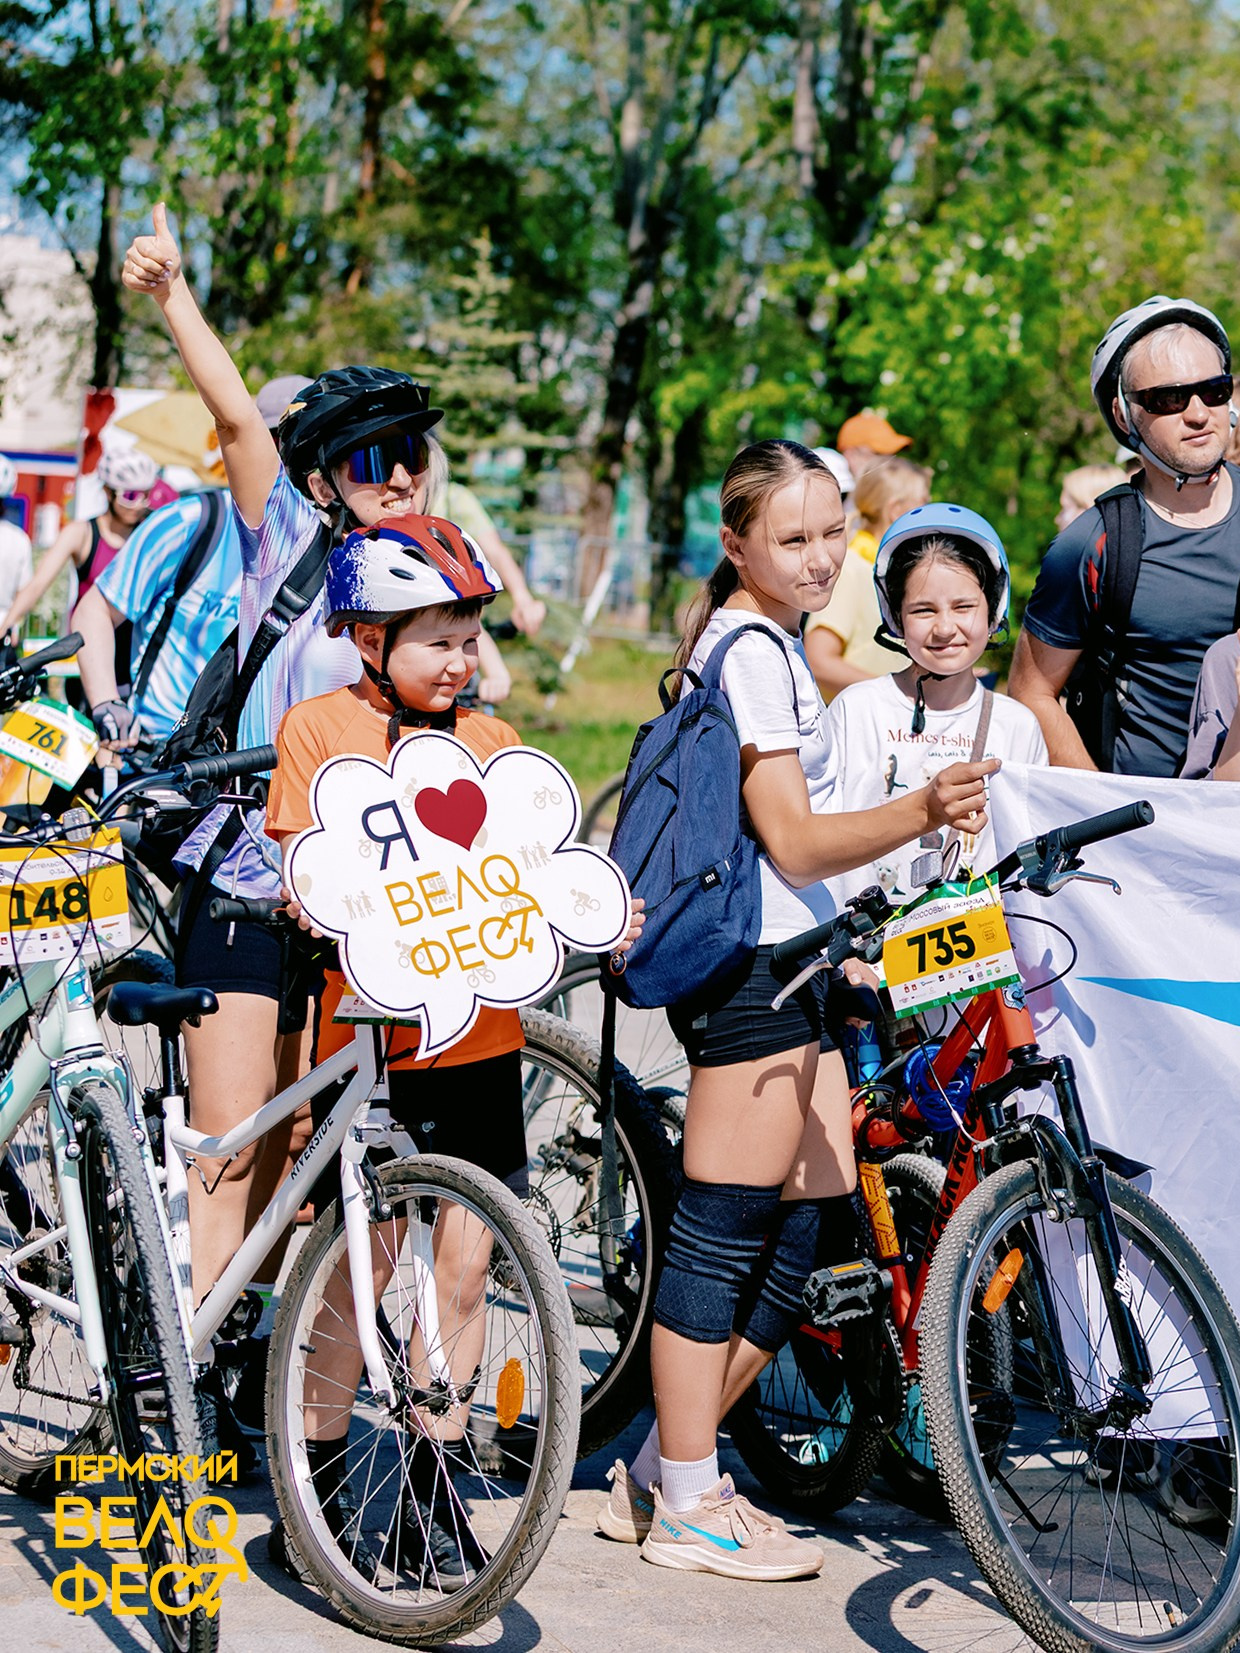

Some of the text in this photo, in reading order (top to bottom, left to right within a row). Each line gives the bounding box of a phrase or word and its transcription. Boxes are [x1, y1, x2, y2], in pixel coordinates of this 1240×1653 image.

[27, 721, 67, 757] 761
[362, 800, 419, 871] Я
[10, 881, 89, 926] 148
[906, 921, 976, 974] 735
[660, 1518, 682, 1540] NIKE
